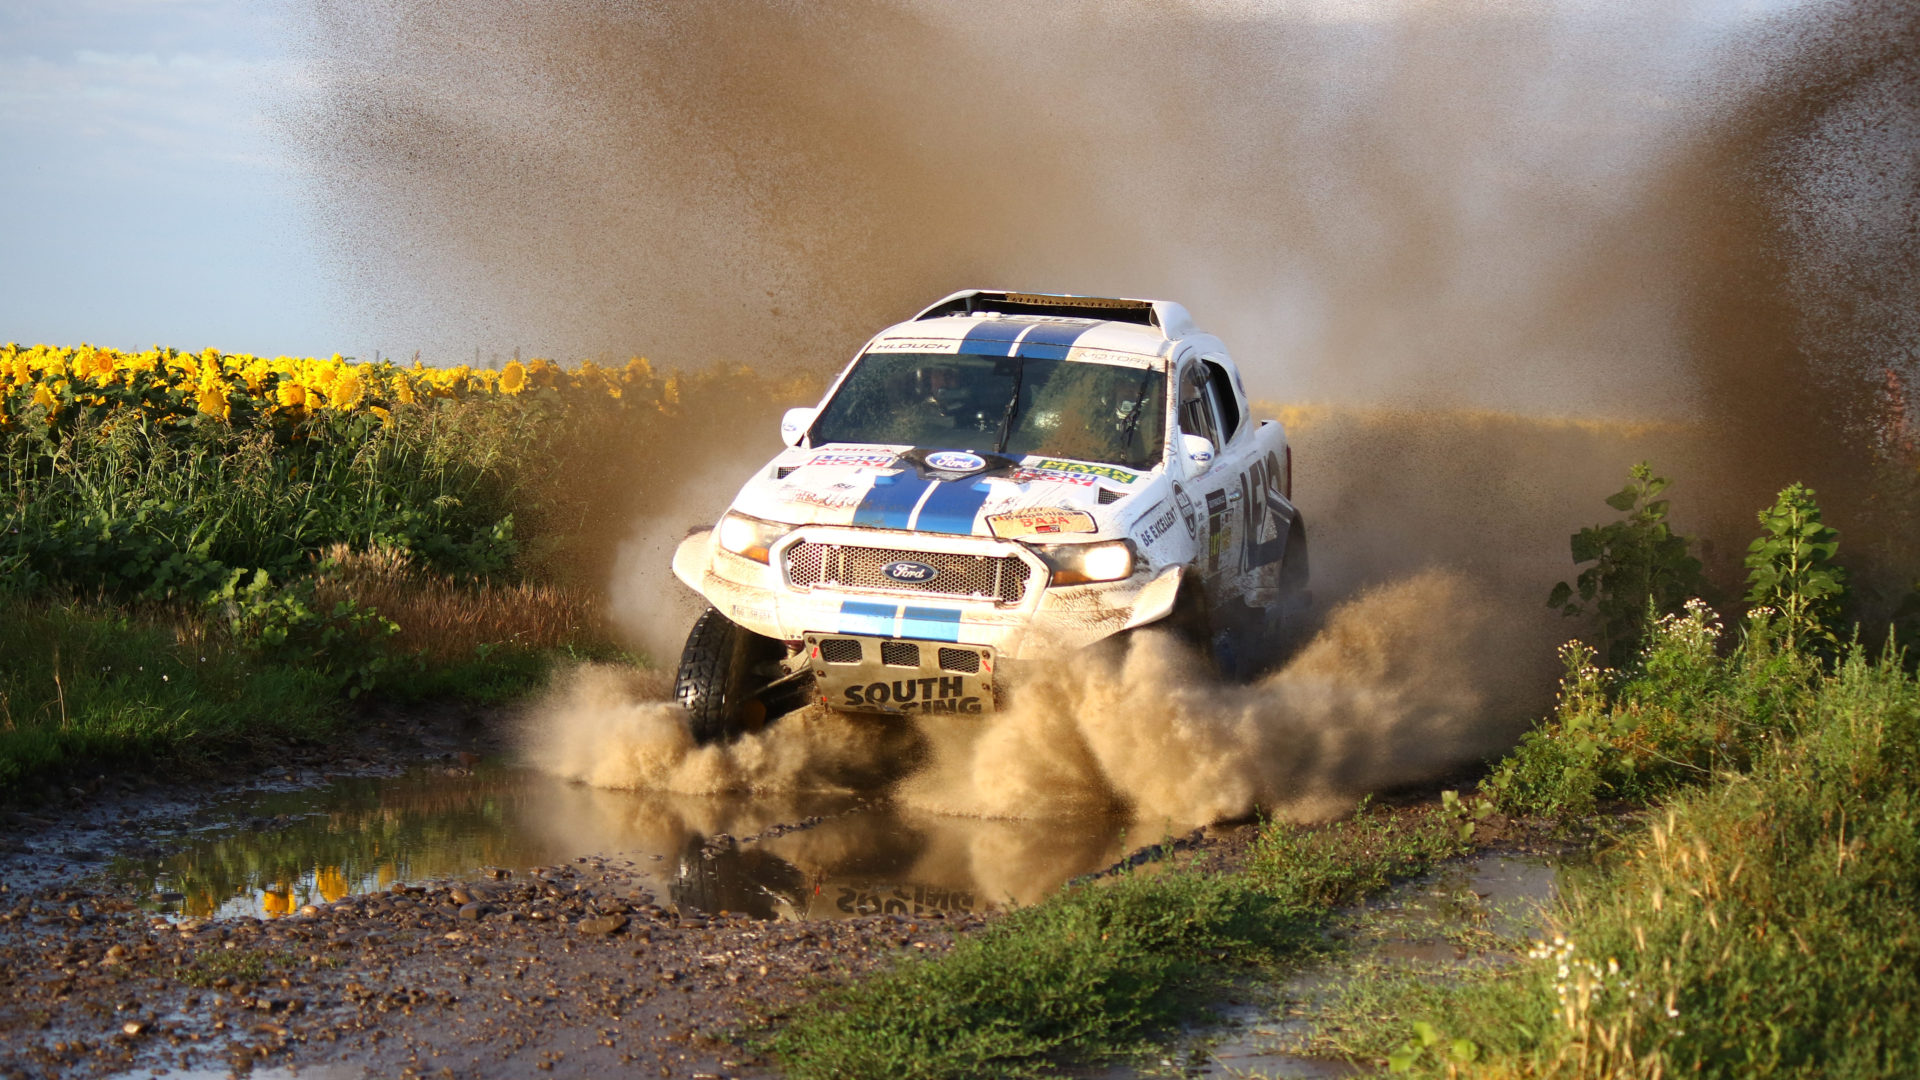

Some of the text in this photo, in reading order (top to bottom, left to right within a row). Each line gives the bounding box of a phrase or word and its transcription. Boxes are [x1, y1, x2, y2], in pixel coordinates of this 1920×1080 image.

[876, 342, 1152, 366] HLOUCH MOTORS
[1020, 516, 1071, 528] BAJA
[1141, 529, 1154, 547] BE
[893, 563, 925, 580] Ford
[844, 676, 963, 706] SOUTH
